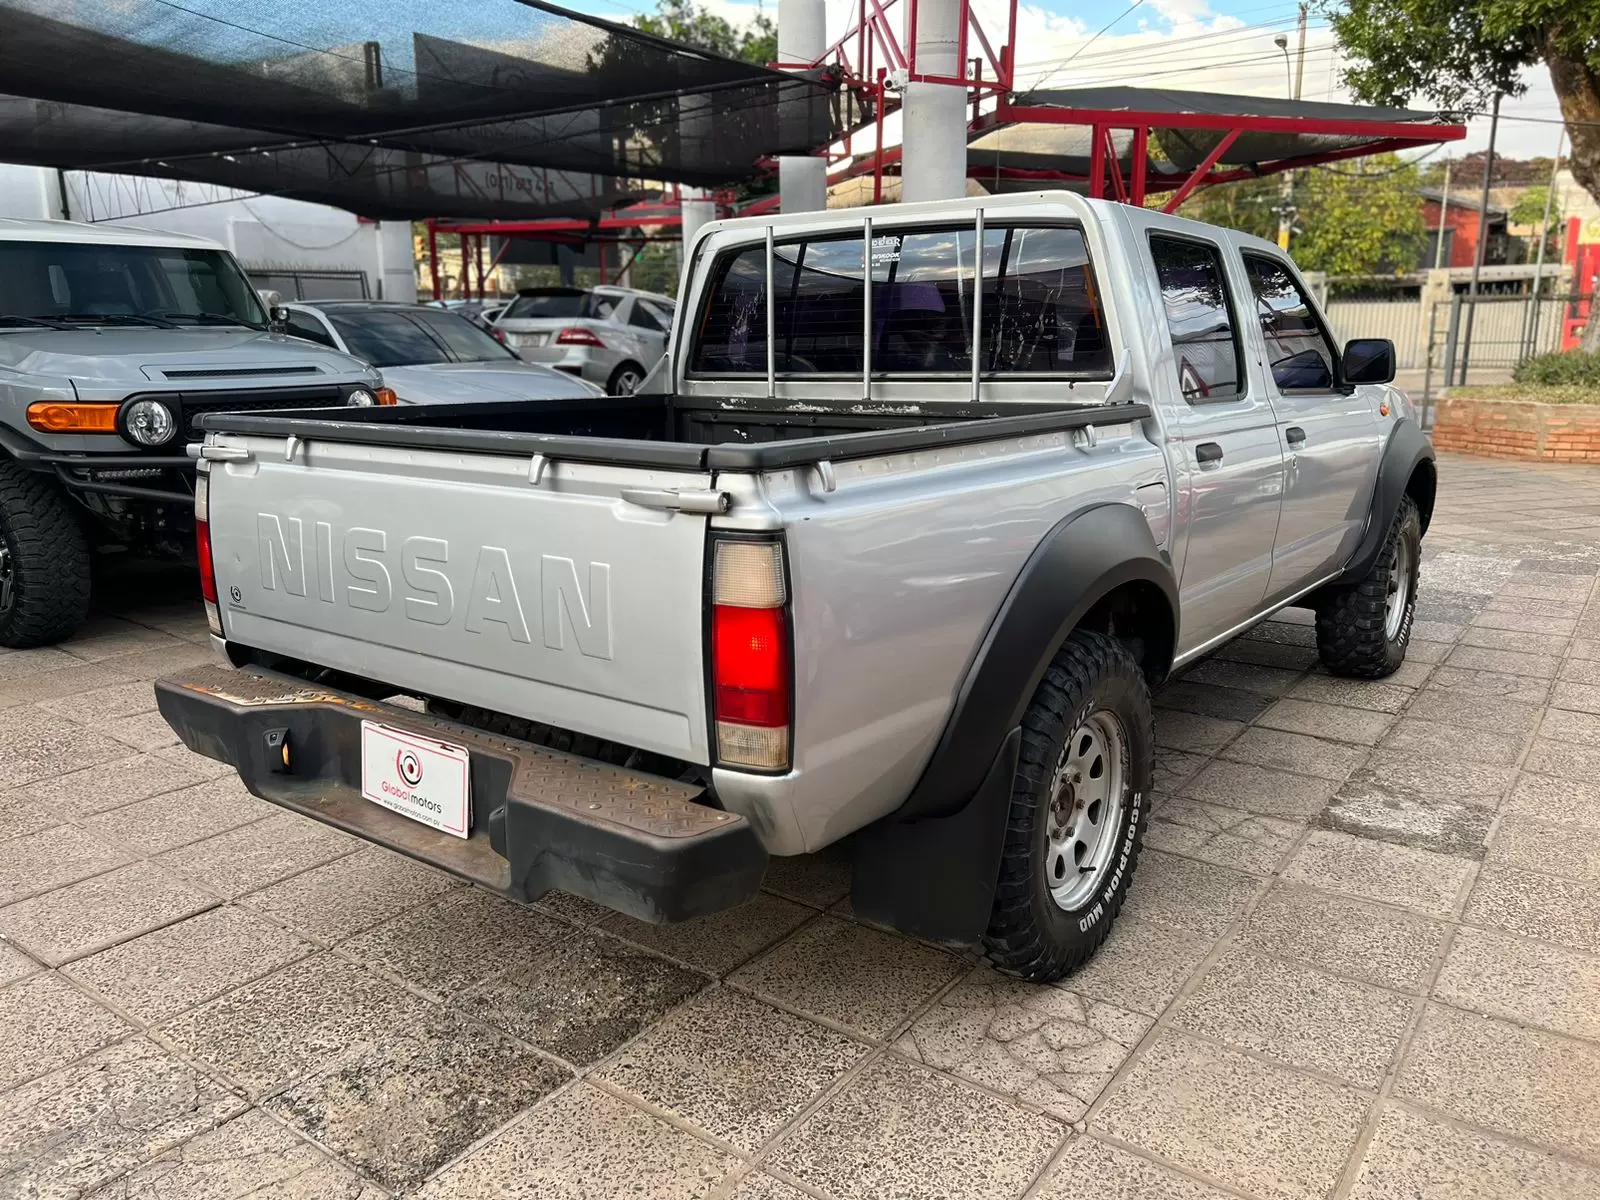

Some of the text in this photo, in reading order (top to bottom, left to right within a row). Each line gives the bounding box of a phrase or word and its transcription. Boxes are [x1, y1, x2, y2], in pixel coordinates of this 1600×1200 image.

[257, 512, 613, 660] NISSAN
[382, 781, 442, 814] Globalmotors
[1079, 792, 1141, 933] SCORPION MUD
